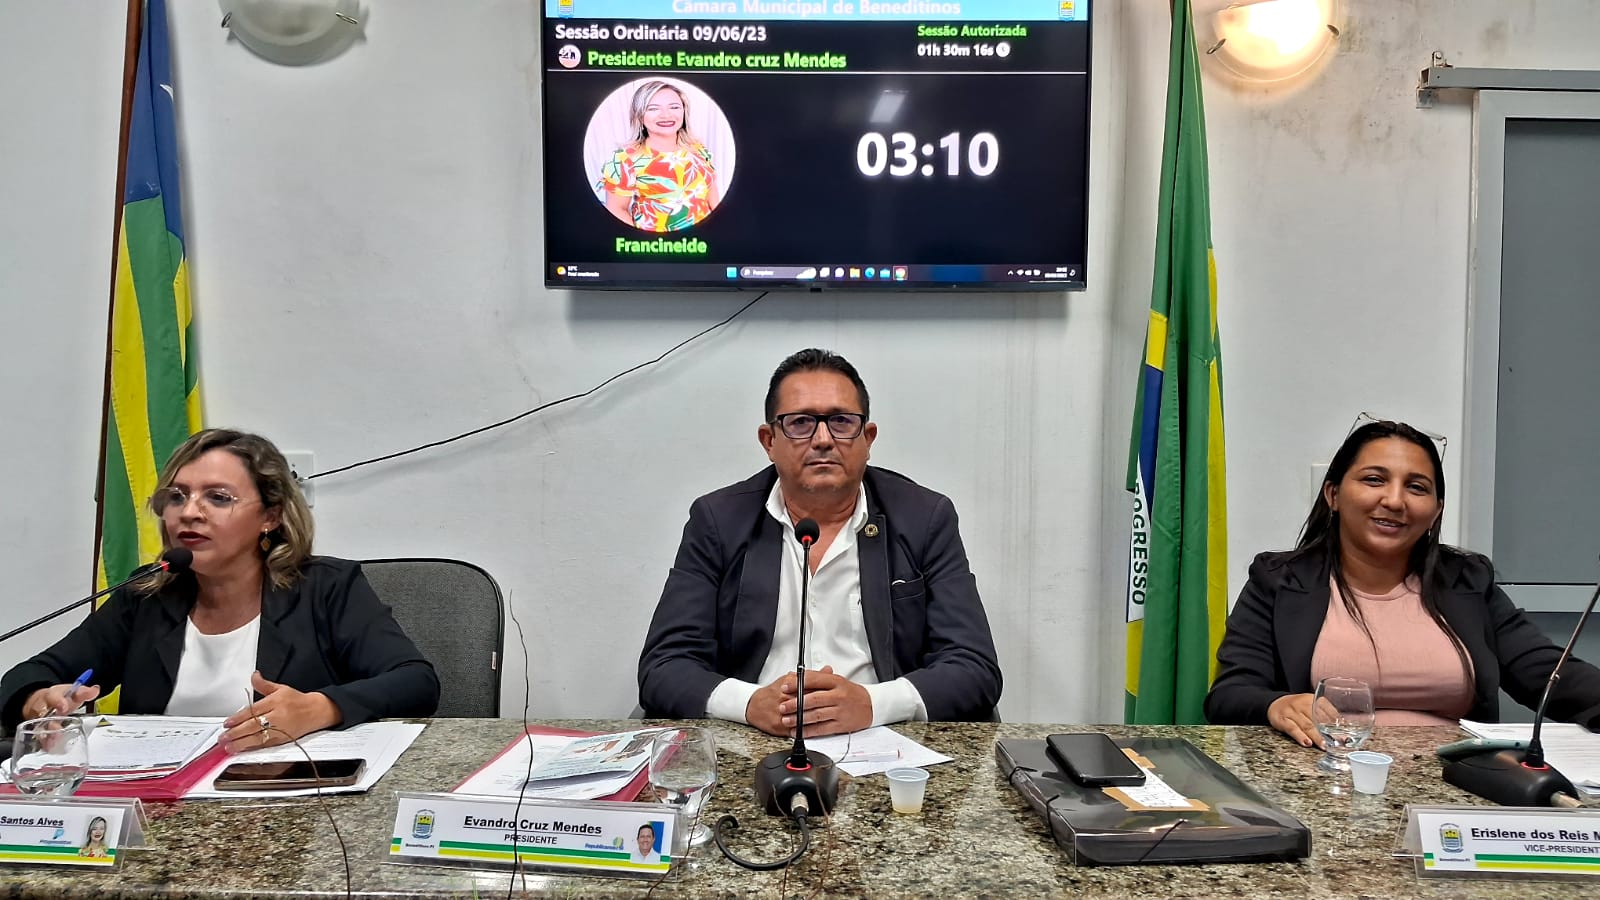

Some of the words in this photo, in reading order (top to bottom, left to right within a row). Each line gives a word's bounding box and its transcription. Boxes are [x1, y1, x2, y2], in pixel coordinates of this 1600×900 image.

[743, 0, 828, 17] Municipal
[833, 0, 854, 14] de
[857, 0, 962, 14] Beneditinos
[556, 23, 609, 40] Sessão
[613, 24, 689, 41] Ordinária
[692, 26, 767, 43] 09/06/23
[917, 24, 959, 38] Sessão
[961, 25, 1028, 38] Autorizada
[917, 43, 941, 56] 01h
[944, 43, 971, 56] 30m
[973, 43, 994, 56] 16s
[587, 51, 673, 67] Presidente
[676, 52, 742, 68] Evandro
[745, 55, 780, 68] cruz
[783, 52, 847, 69] Mendes
[855, 131, 1000, 178] 03:10
[614, 236, 708, 255] Francineide
[0, 816, 34, 825] Santos
[37, 817, 64, 827] Alves
[464, 816, 516, 829] Evandro
[520, 819, 549, 831] Cruz
[552, 821, 603, 834] Mendes
[504, 833, 558, 845] PRESIDENTE
[1471, 827, 1526, 839] Erislene
[1531, 829, 1555, 840] dos
[1559, 830, 1590, 841] Reis
